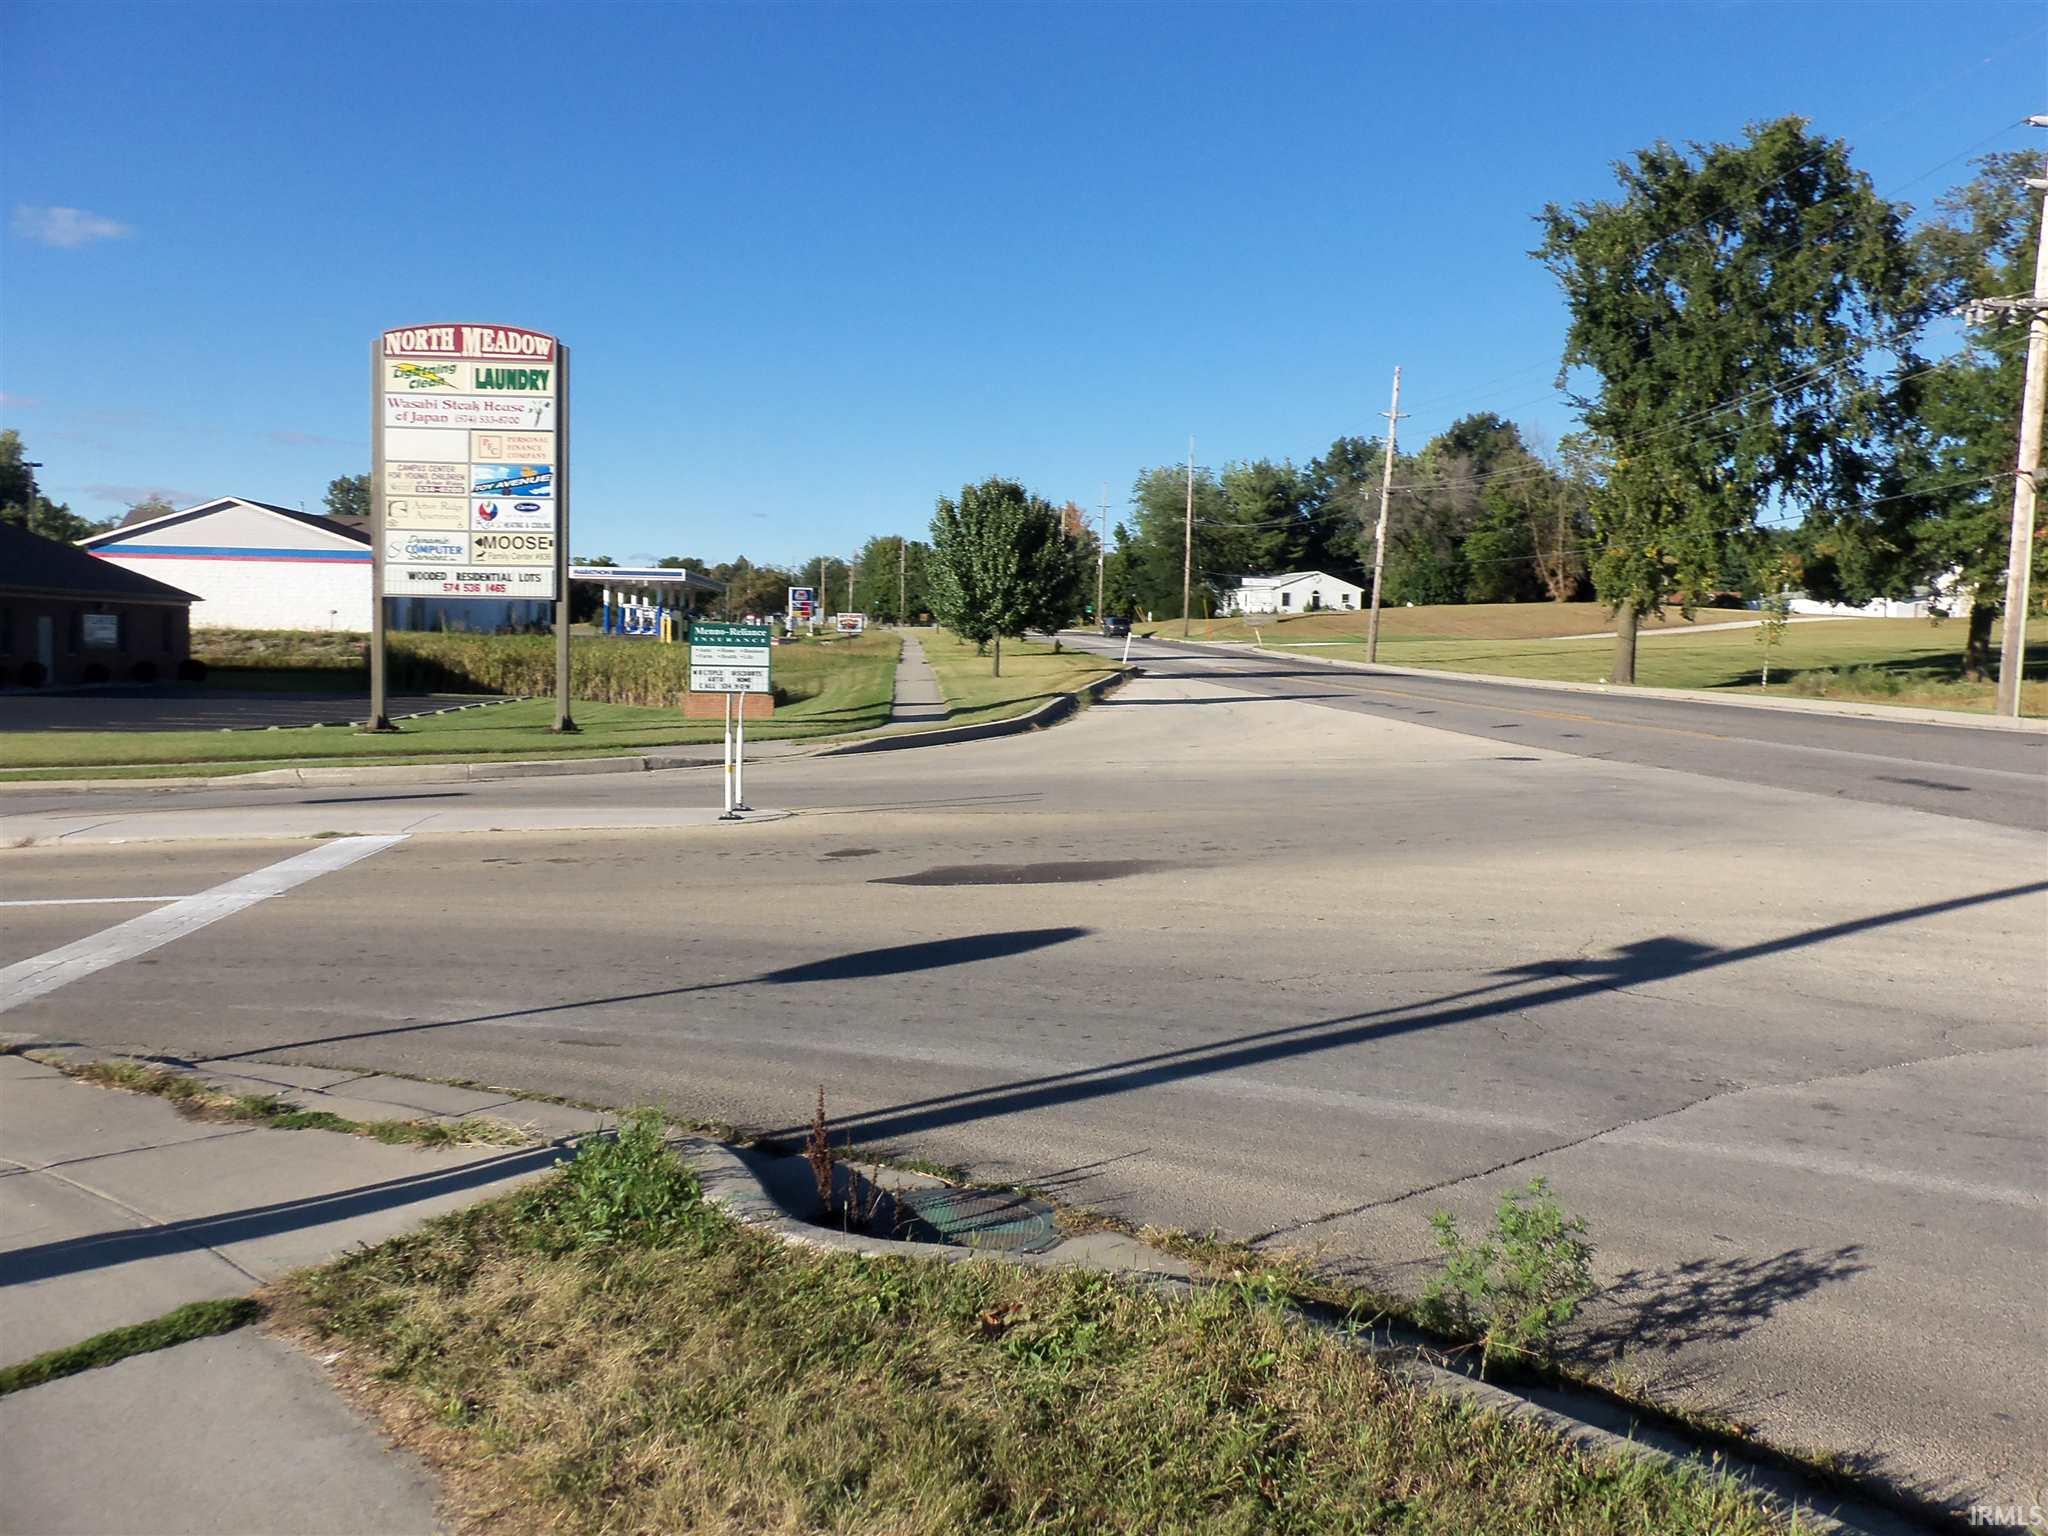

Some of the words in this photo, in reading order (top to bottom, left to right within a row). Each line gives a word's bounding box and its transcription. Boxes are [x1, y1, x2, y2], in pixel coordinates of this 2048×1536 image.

[385, 327, 455, 354] NORTH
[461, 327, 552, 357] MEADOW
[394, 364, 457, 379] Ligning
[409, 379, 443, 389] Clea
[475, 368, 549, 390] LAUNDRY
[387, 398, 438, 409] Wasabi
[442, 399, 480, 411] Steak
[484, 402, 525, 412] House
[395, 411, 408, 421] of
[409, 411, 449, 424] Japan
[495, 474, 553, 488] AVENUE
[405, 544, 463, 554] COMPUTER
[483, 536, 549, 549] MOOSE
[407, 572, 447, 580] WOODED
[456, 572, 512, 581] RESIDENTIAL
[519, 573, 542, 582] LOTS
[443, 583, 460, 592] 574
